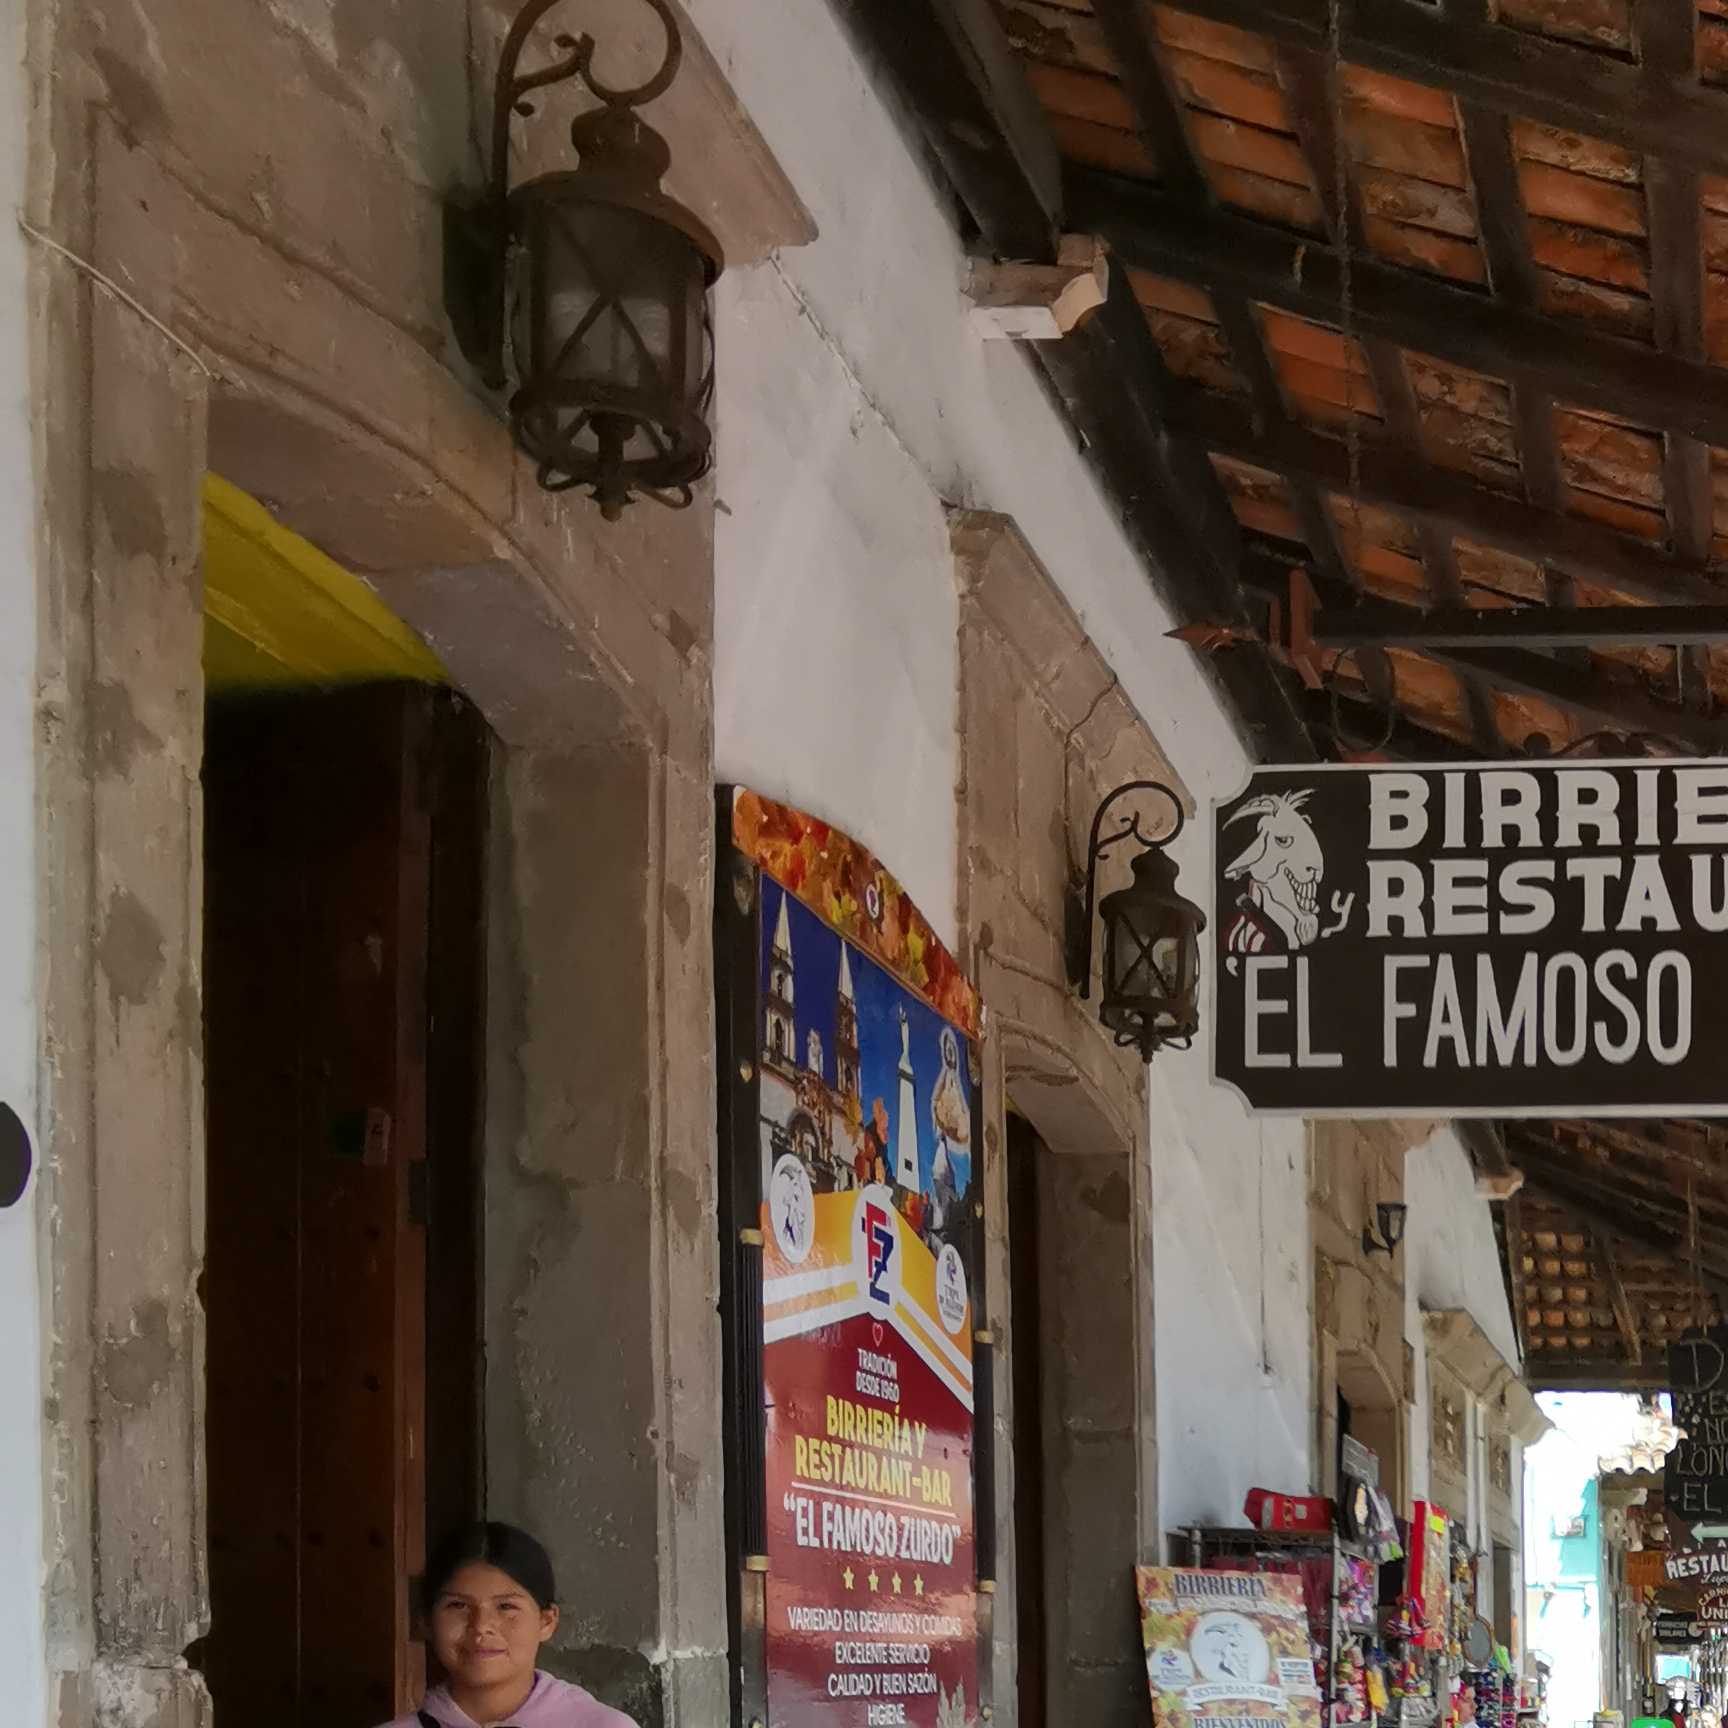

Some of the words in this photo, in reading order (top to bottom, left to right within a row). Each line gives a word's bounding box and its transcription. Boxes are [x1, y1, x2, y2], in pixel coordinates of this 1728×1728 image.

[1320, 889, 1356, 938] y
[1383, 951, 1691, 1068] FAMOSO
[857, 1347, 898, 1380] TRADICIÓN
[855, 1371, 880, 1397] DESDE
[827, 1395, 913, 1458] BIRRIERÍA
[914, 1420, 928, 1459] Y
[795, 1435, 952, 1507] RESTAURANT-BAR
[1683, 1482, 1722, 1514] EL
[822, 1501, 897, 1558] FAMOSO
[1717, 1539, 1727, 1549] A
[787, 1606, 842, 1632] VARIEDAD
[844, 1610, 858, 1633] EN
[859, 1611, 914, 1635] DESAYUNOS
[914, 1613, 922, 1635] Y
[922, 1616, 963, 1637] COMIDAS
[834, 1641, 888, 1664] EXCELENTE
[889, 1643, 931, 1664] SERVICIO
[827, 1673, 873, 1697] CALIDAD
[873, 1674, 882, 1695] Y
[882, 1674, 906, 1695] BUEN
[907, 1667, 937, 1694] SAZÓN
[868, 1703, 906, 1726] HIGIENE
